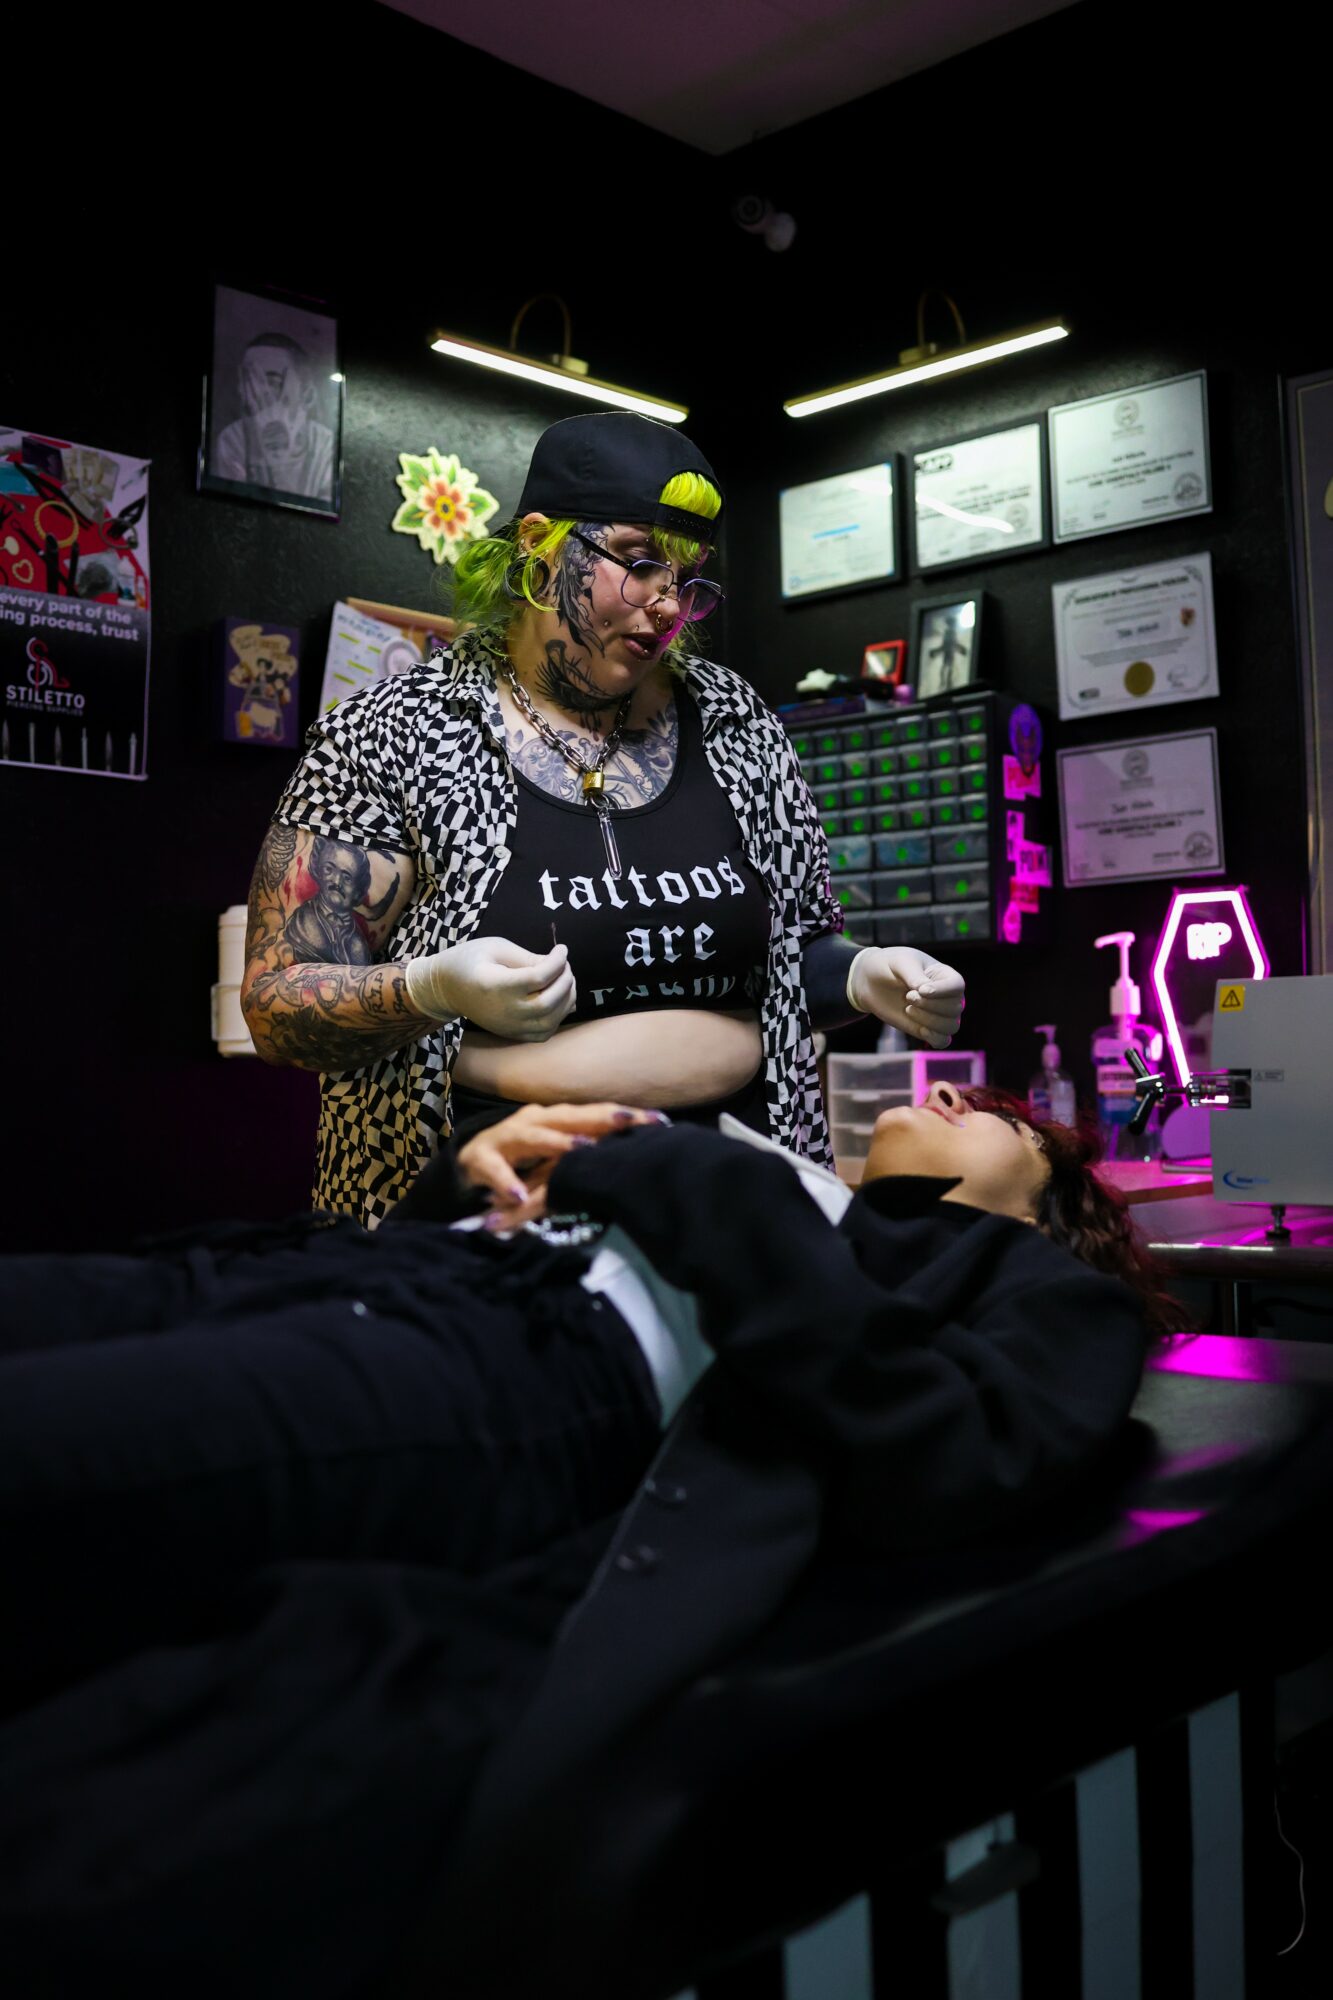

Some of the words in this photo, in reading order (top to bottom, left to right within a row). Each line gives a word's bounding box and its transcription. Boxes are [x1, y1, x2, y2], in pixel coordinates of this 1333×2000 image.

[0, 592, 44, 612] every
[48, 601, 82, 616] part
[85, 607, 102, 619] of
[106, 609, 132, 624] the
[30, 613, 97, 635] process,
[101, 623, 139, 640] trust
[6, 685, 85, 708] STILETTO
[538, 855, 746, 910] tattoos
[624, 922, 717, 967] are
